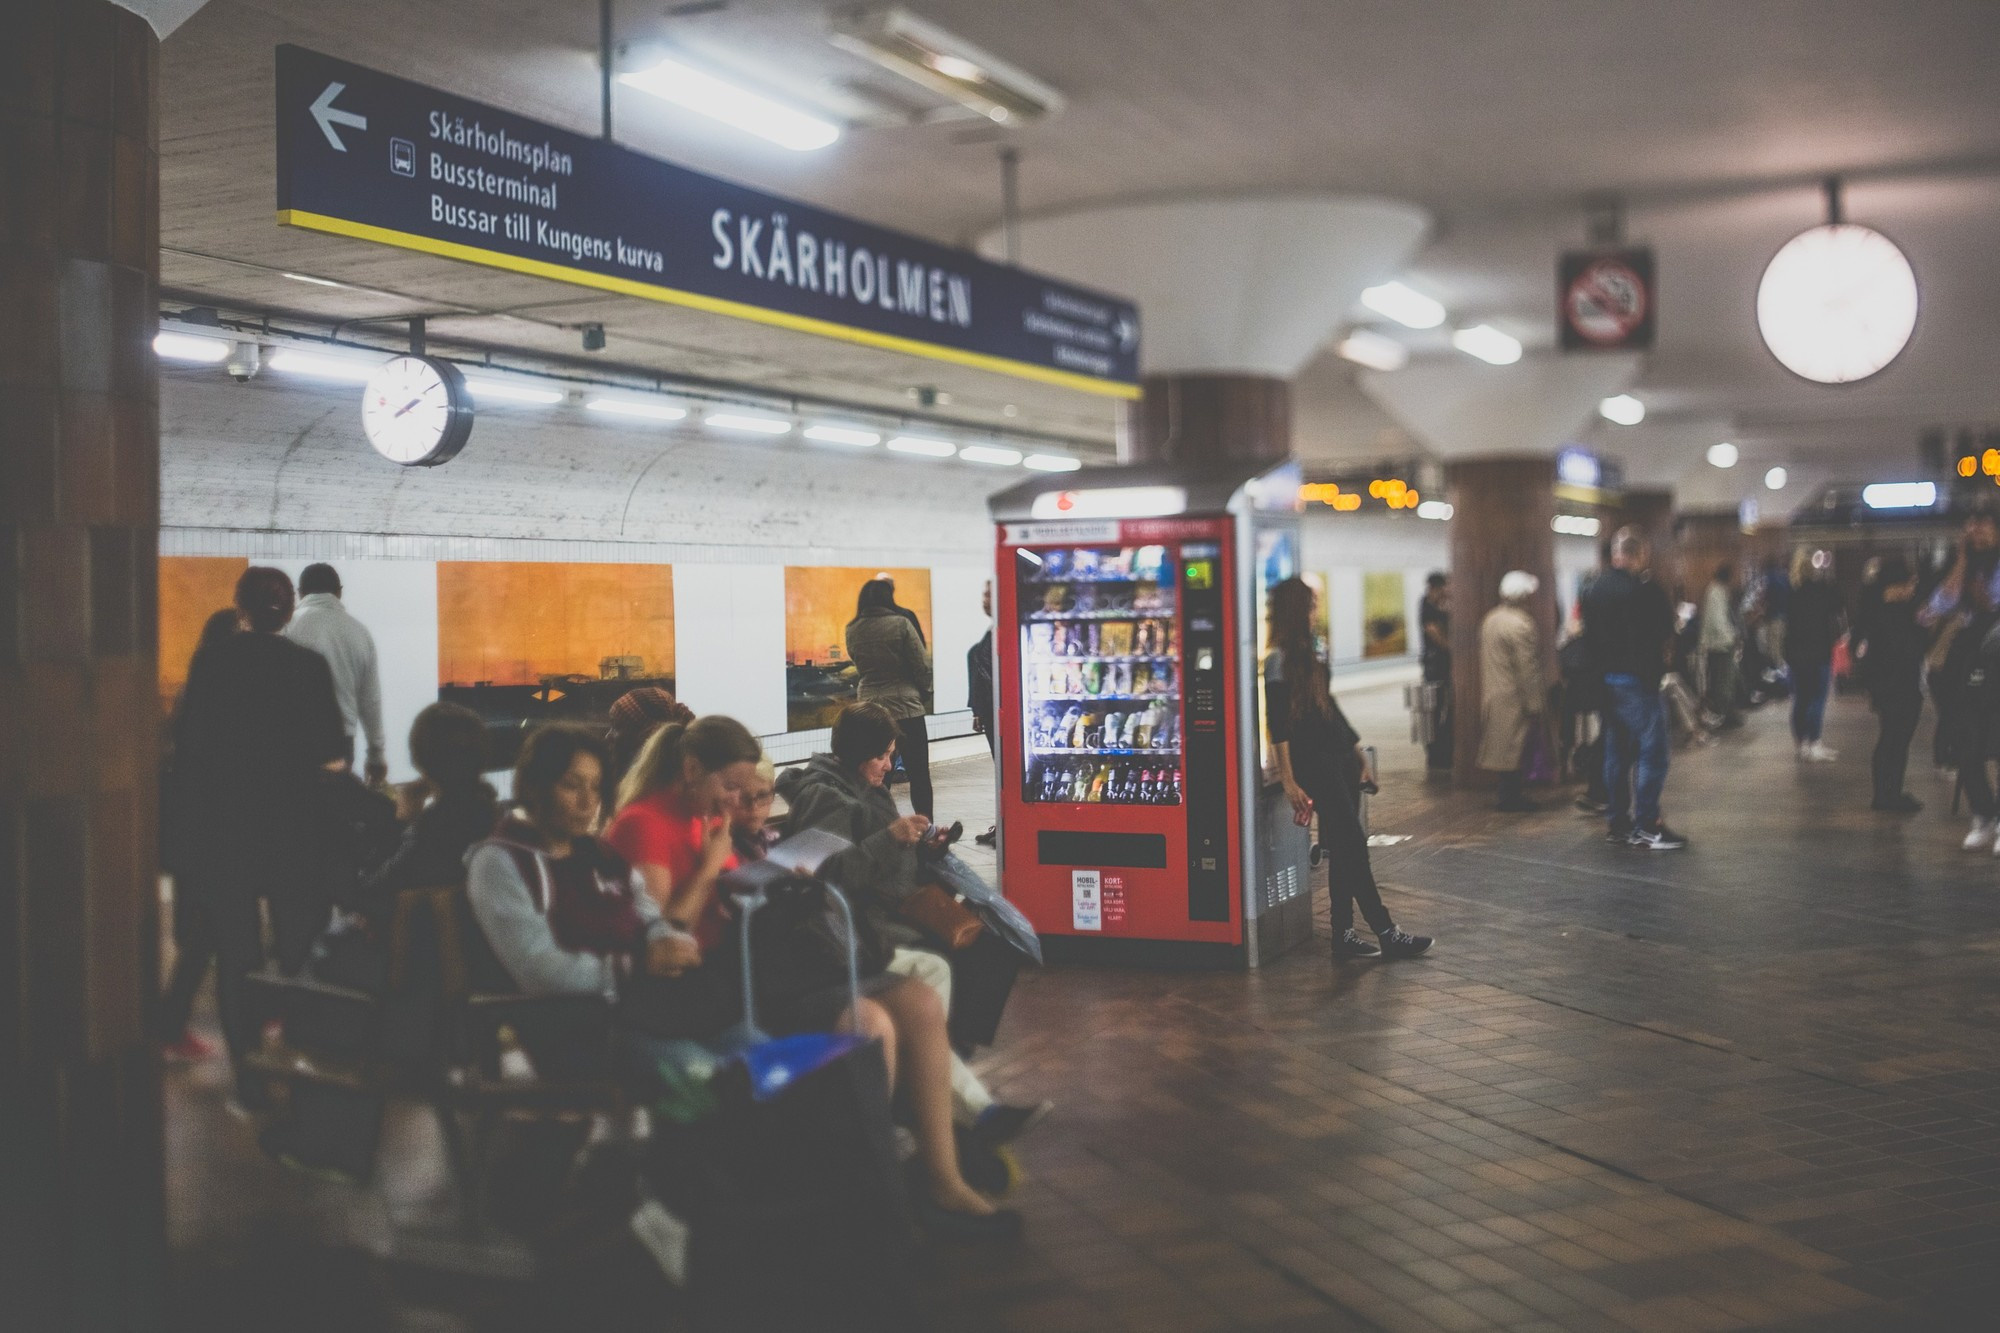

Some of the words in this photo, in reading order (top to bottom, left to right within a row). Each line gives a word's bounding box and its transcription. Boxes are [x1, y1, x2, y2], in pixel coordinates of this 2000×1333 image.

[429, 110, 572, 176] Skärholmsplan
[430, 152, 557, 210] Bussterminal
[431, 194, 498, 235] Bussar
[503, 213, 531, 242] till
[537, 220, 613, 261] Kungens
[617, 237, 664, 273] kurva
[711, 207, 973, 328] SKÄRHOLMEN
